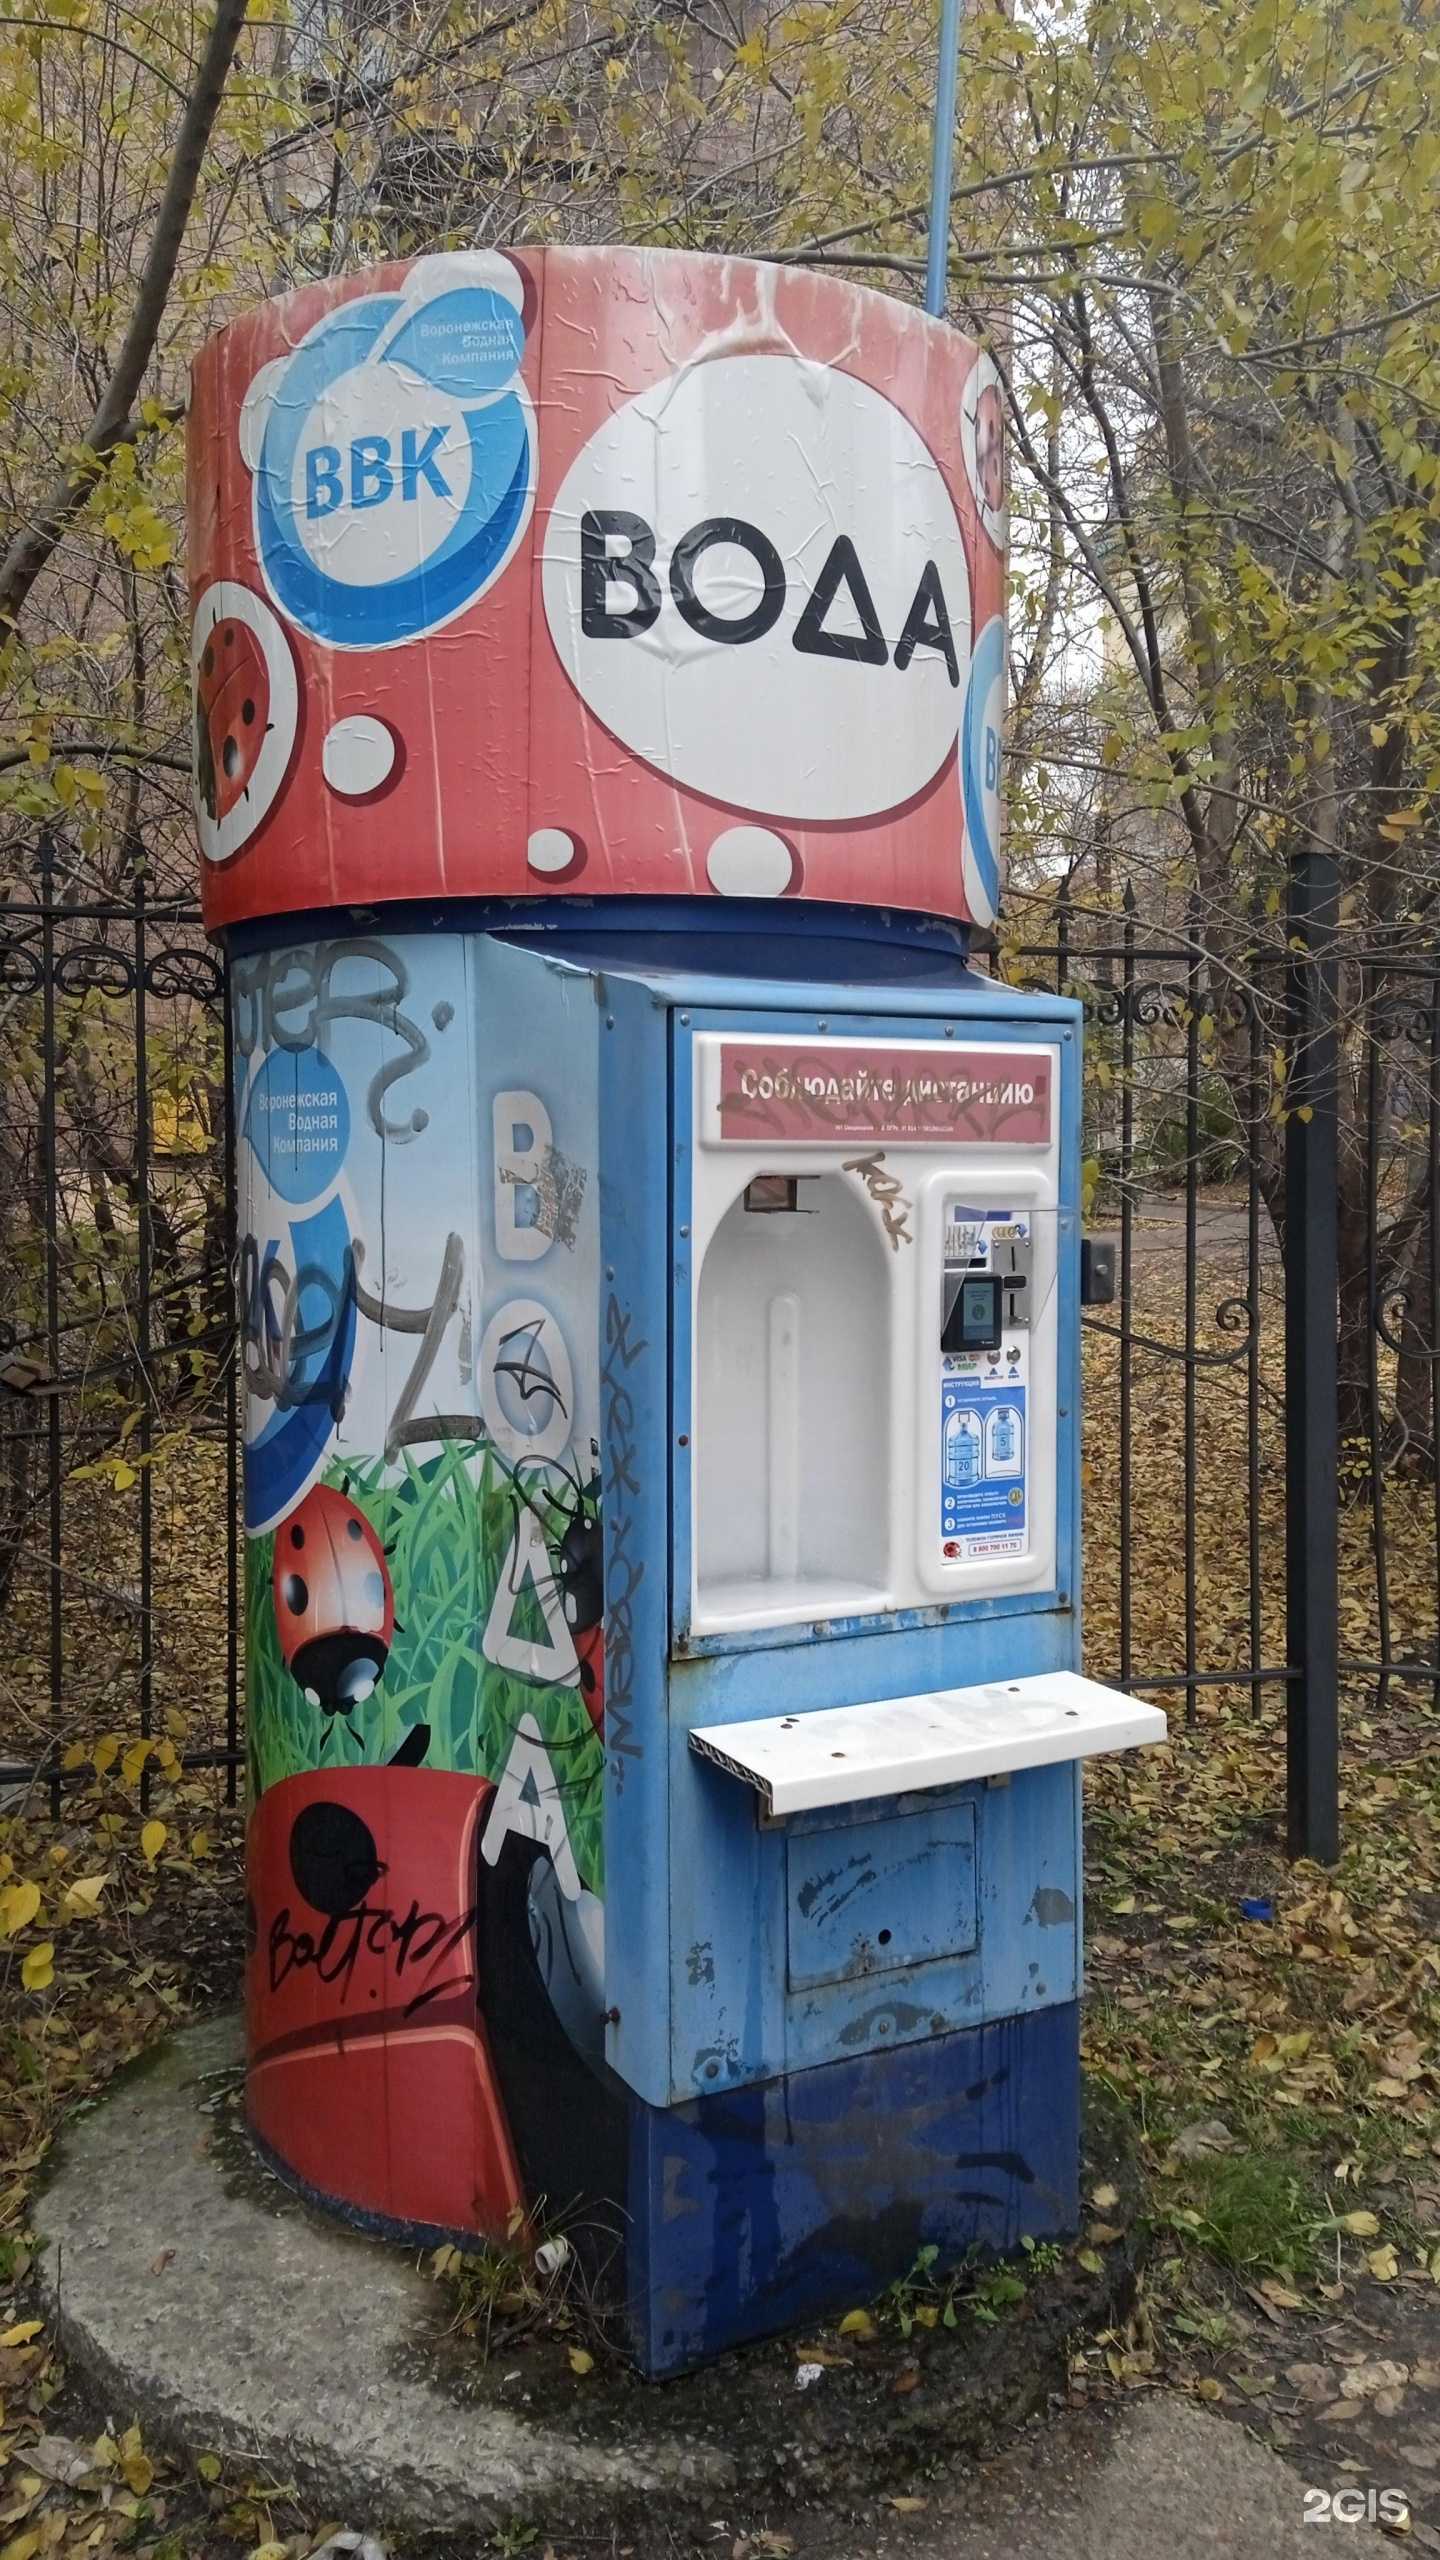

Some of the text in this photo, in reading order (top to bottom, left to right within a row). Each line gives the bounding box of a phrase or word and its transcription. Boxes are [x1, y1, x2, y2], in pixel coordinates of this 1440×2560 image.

[420, 319, 514, 337] Воронежская
[442, 350, 514, 365] Компания
[306, 425, 453, 520] ВВК
[581, 510, 960, 688] ВОДА
[259, 1092, 338, 1112] Воронежская
[288, 1112, 338, 1132] Водная
[273, 1136, 338, 1154] Компания
[1000, 1436, 1006, 1447] 5
[958, 1461, 969, 1471] 20
